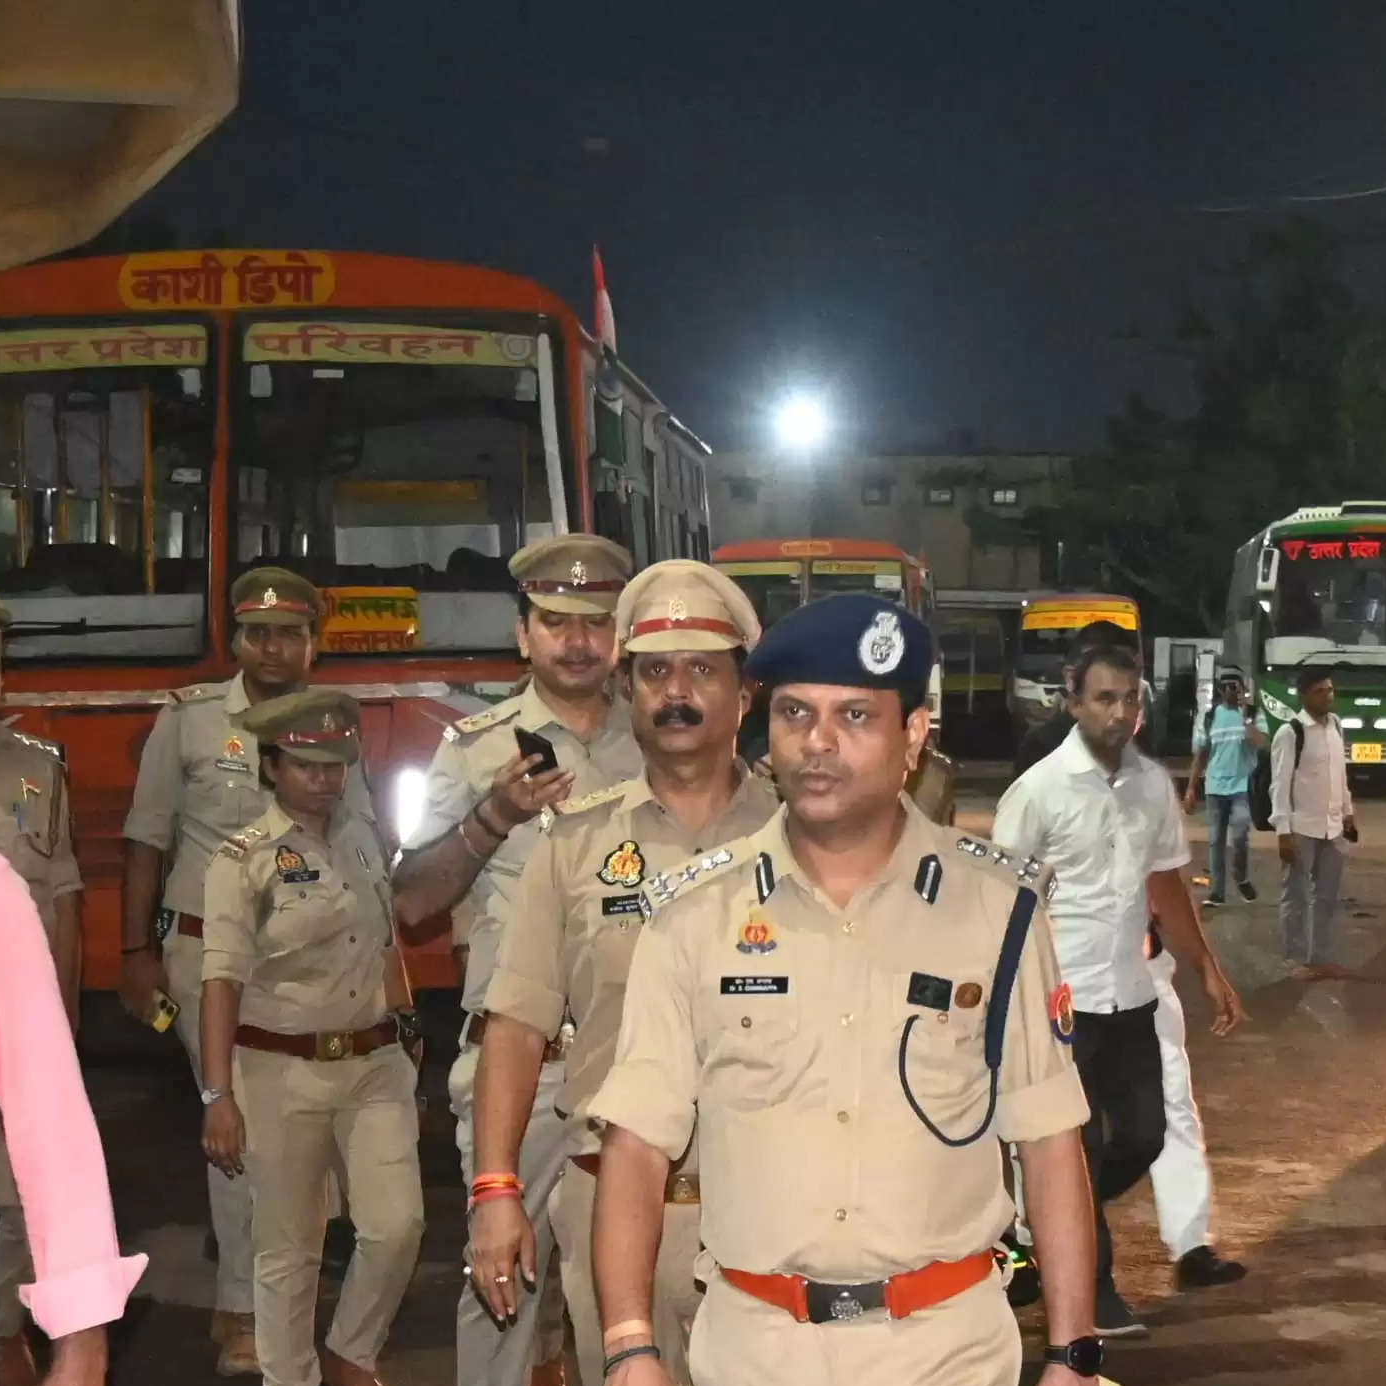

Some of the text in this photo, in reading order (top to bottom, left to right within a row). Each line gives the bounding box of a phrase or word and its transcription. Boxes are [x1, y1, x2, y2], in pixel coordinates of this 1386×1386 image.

[131, 252, 324, 305] काशी डिपो
[89, 326, 206, 362] प्रदेश
[249, 324, 483, 359] परिवहन
